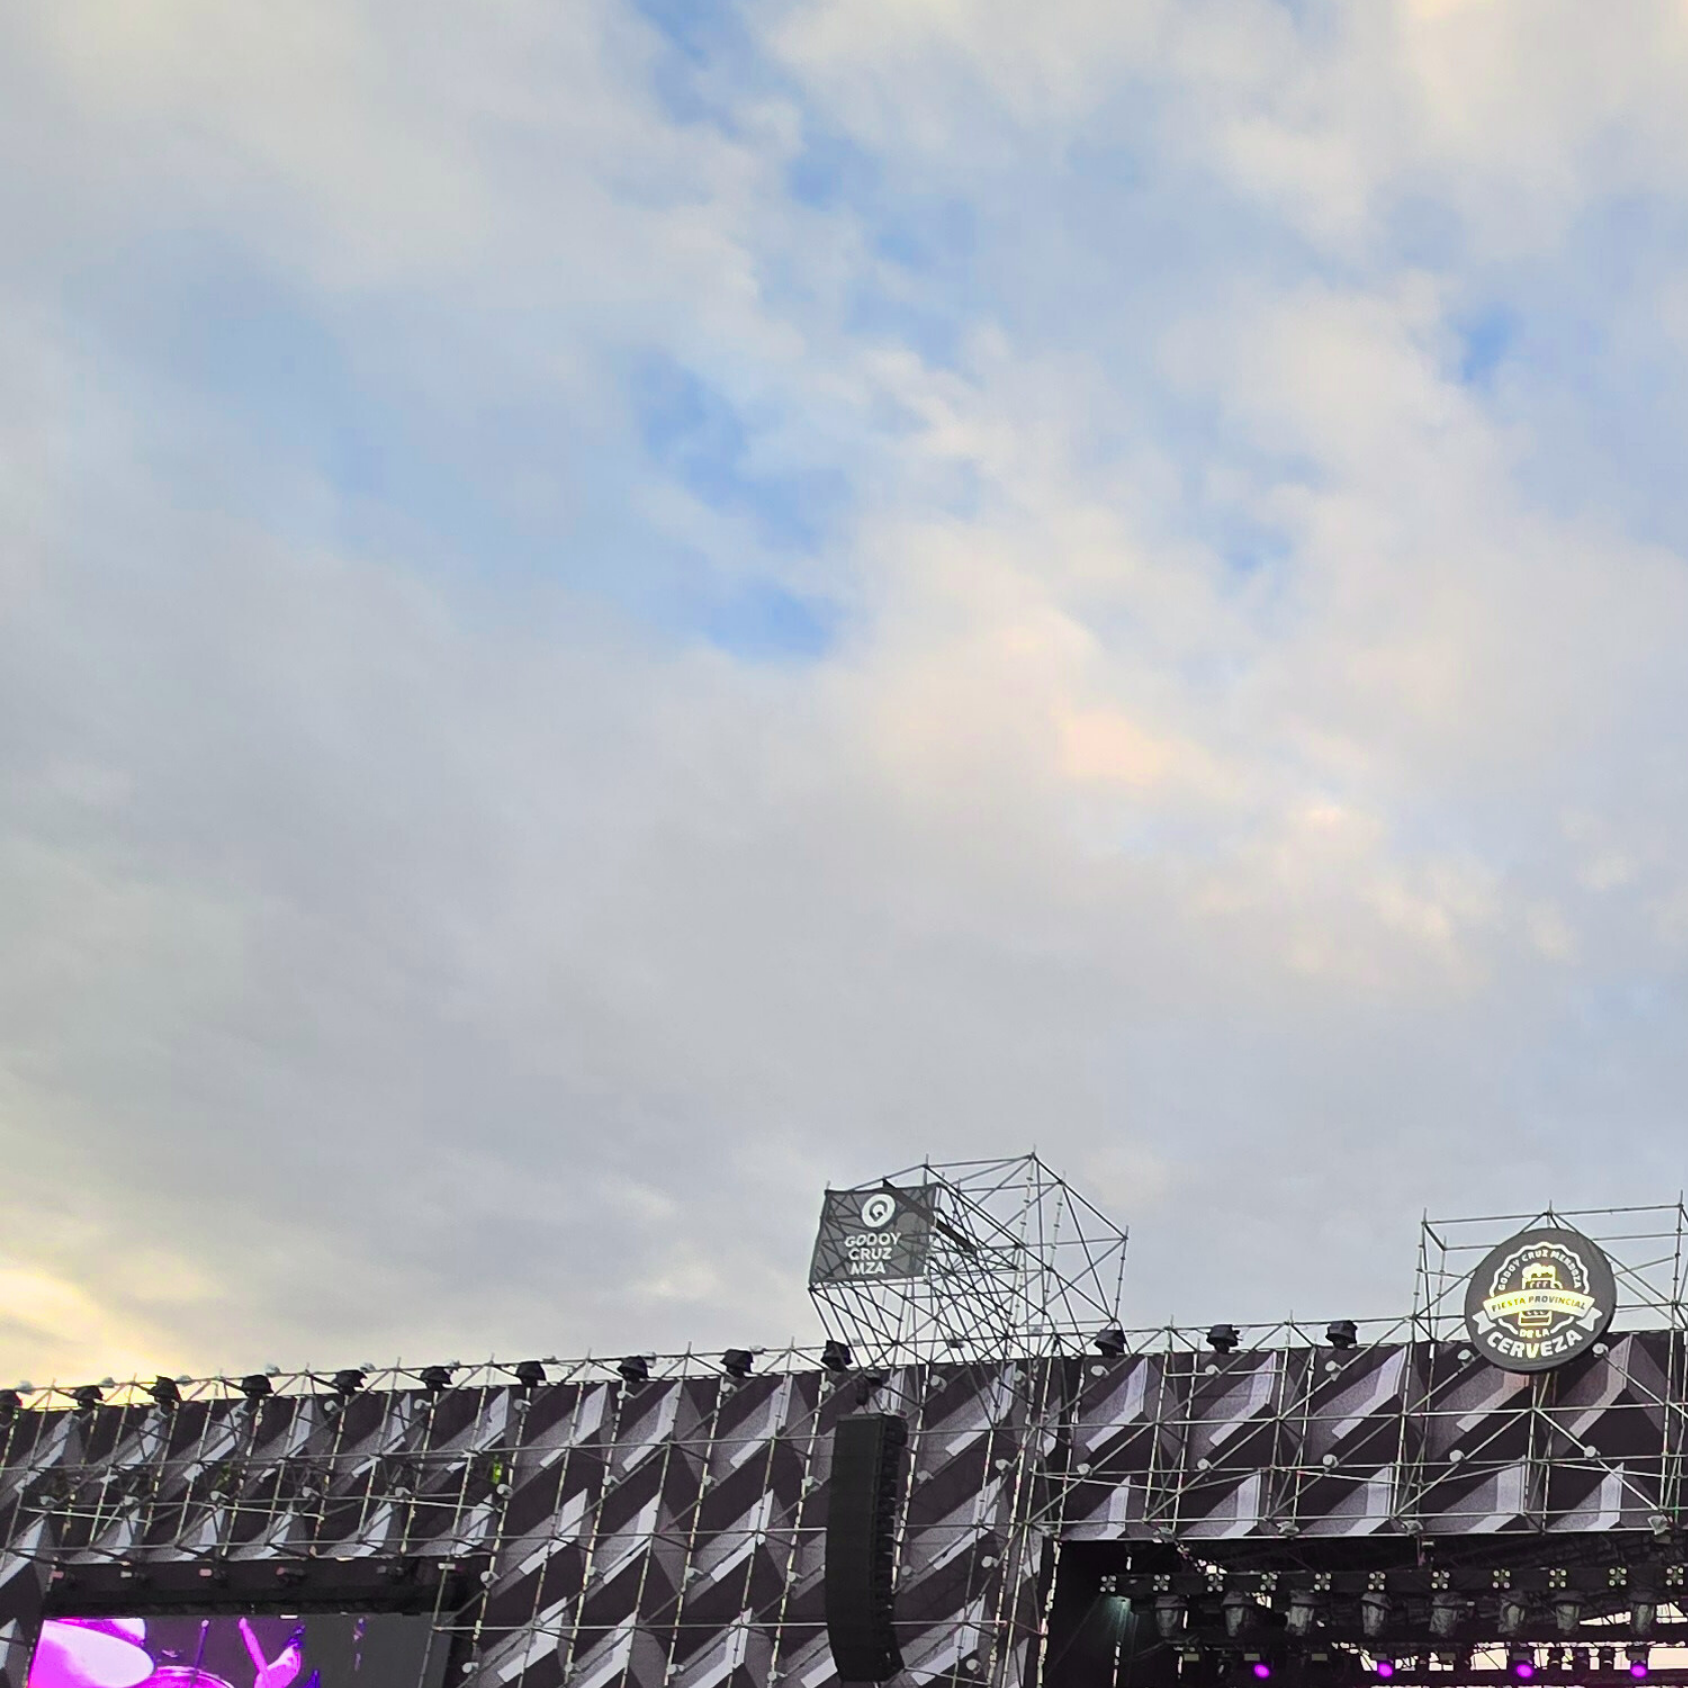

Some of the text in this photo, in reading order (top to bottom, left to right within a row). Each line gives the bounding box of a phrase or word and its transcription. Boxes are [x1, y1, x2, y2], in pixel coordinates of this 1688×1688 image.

[844, 1232, 901, 1248] GODOY
[848, 1247, 893, 1261] CRUZ
[849, 1261, 886, 1275] MZA
[1498, 1249, 1582, 1291] GODOY CRUZ MENDOZA
[1491, 1295, 1586, 1313] FIESTA PROVINCIAL
[1486, 1329, 1584, 1359] CERVEZA
